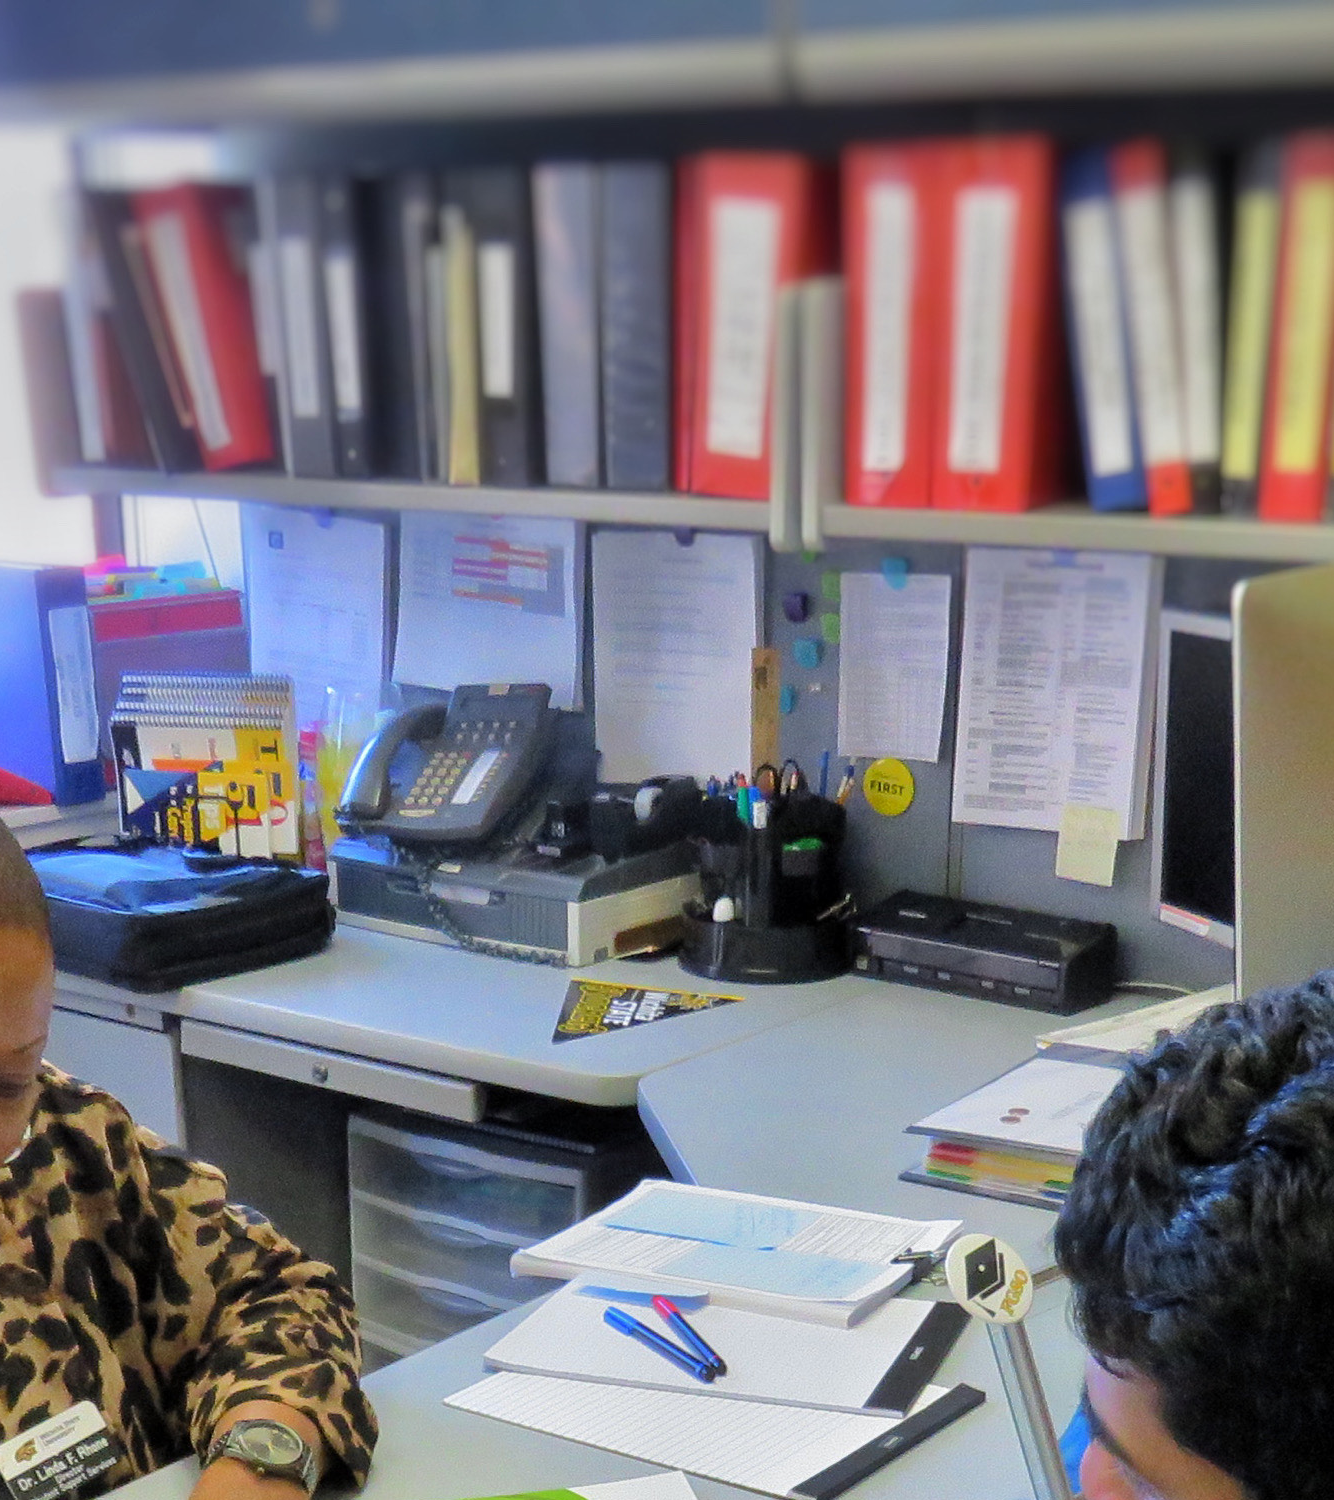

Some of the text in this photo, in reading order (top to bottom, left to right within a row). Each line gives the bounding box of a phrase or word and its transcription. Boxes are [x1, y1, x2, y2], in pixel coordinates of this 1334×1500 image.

[869, 780, 905, 796] FIRST
[602, 999, 638, 1026] STATE
[17, 1477, 38, 1491] Dr.
[35, 1460, 67, 1481] Linda
[65, 1451, 79, 1465] F.
